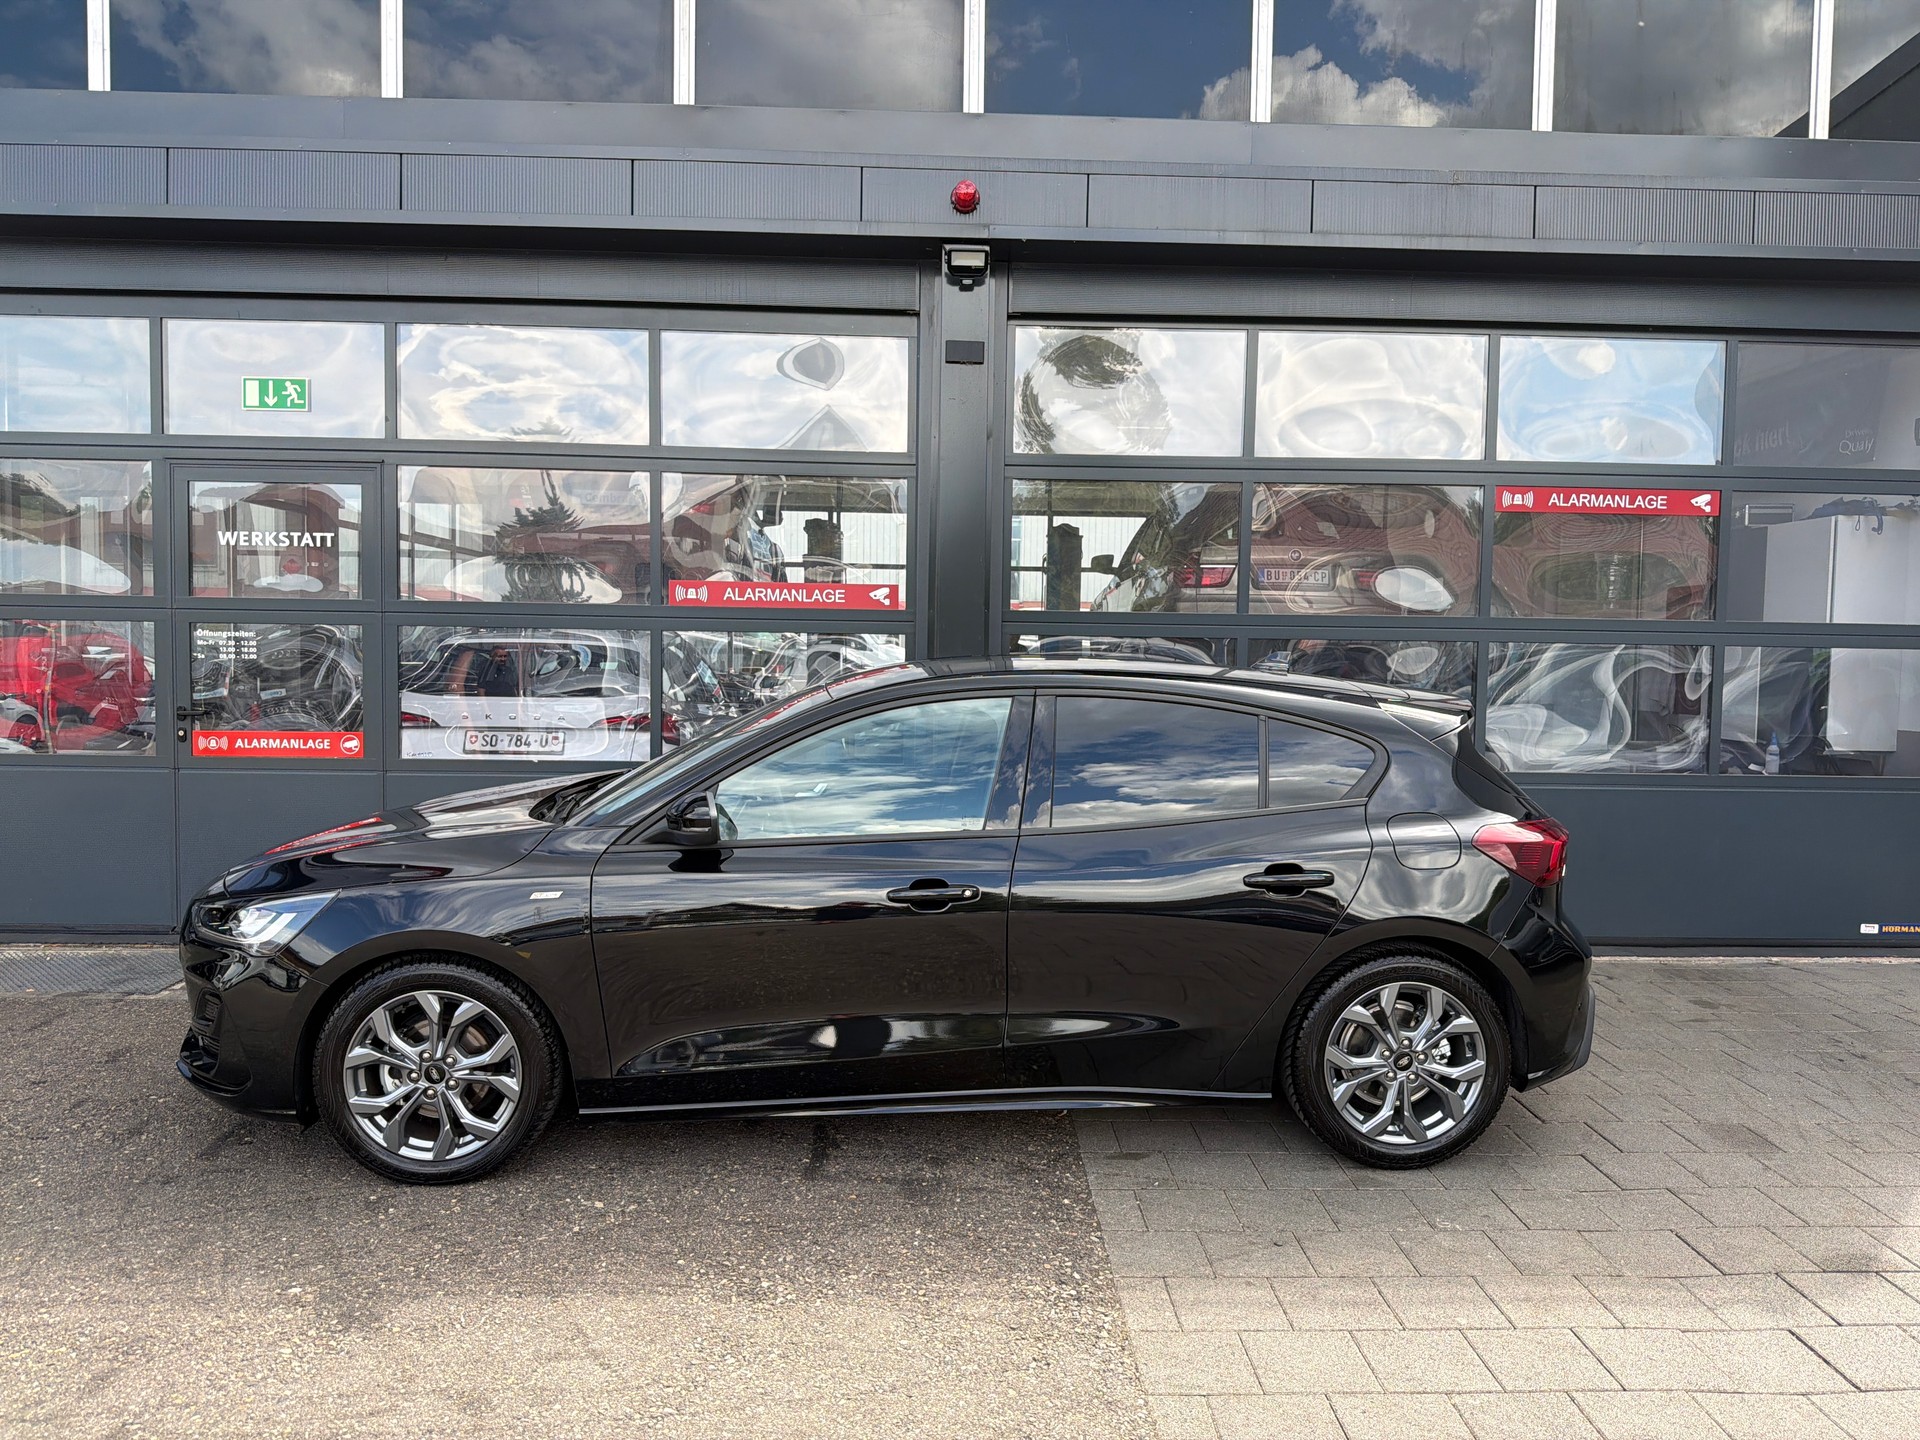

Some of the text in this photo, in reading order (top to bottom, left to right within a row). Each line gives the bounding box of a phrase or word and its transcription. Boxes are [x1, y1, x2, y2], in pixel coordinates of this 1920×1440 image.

[1547, 492, 1668, 510] ALARMANLAGE
[217, 530, 335, 548] WERKSTATT
[722, 586, 846, 604] ALARMANLAGE
[234, 738, 331, 750] ALARMANLAGE
